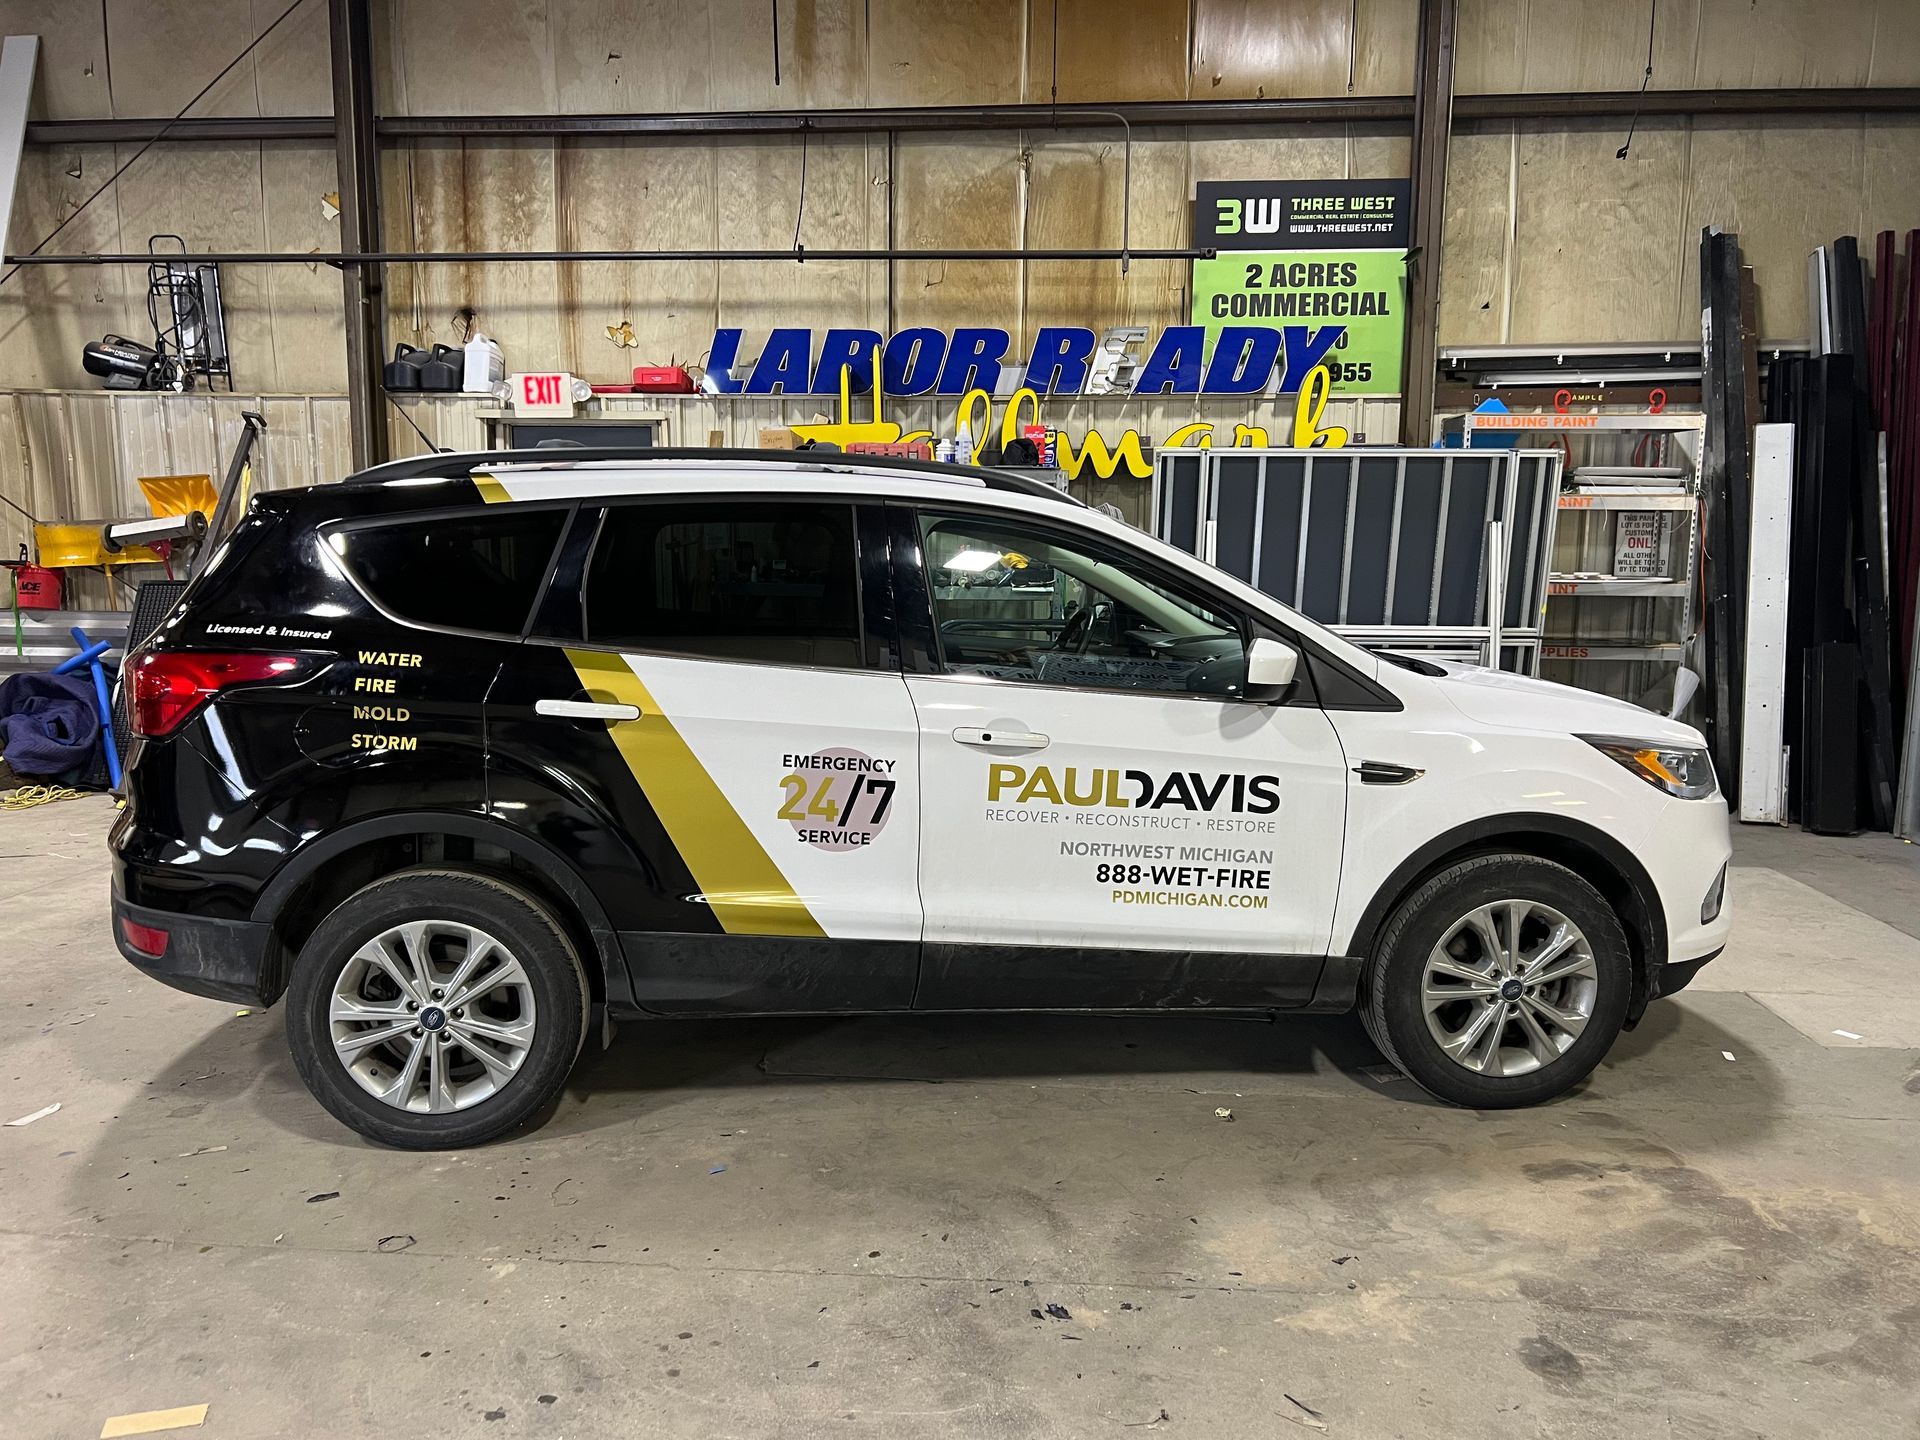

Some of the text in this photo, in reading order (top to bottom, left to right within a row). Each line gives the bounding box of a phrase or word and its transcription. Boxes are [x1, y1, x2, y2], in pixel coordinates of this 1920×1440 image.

[1291, 196, 1396, 211] THREE WEST
[1215, 198, 1281, 235] 3W
[1289, 223, 1394, 233] WWW.THREEWEST.NET
[1245, 262, 1357, 288] 2 ACRES
[1211, 291, 1390, 318] COMMERCIAL
[706, 325, 1348, 397] LABOR READY
[523, 375, 561, 404] EXIT
[1476, 416, 1599, 427] BUILDING PAINT
[1557, 495, 1593, 508] AINT
[1620, 521, 1633, 529] LOT
[1634, 521, 1640, 529] IS
[1623, 514, 1638, 522] THIS
[1627, 536, 1653, 549] ONL
[205, 623, 333, 640] Licensed & Insured
[357, 650, 423, 668] WATER
[1537, 647, 1589, 658] PPLIES
[354, 677, 397, 694] FIRE
[352, 705, 411, 722] MOLD
[350, 733, 418, 751] STORM
[782, 754, 896, 773] EMERGENCY
[777, 773, 897, 827] 24/7
[985, 808, 1277, 834] RECOVER RECONSTRUCT RESTORE
[797, 829, 871, 845] SERVICE
[1059, 840, 1274, 865] NORTHWEST MICHIGAN
[1095, 863, 1272, 890] 888-WET-FIRE
[1112, 890, 1269, 909] PDMICHIGAN.COM
